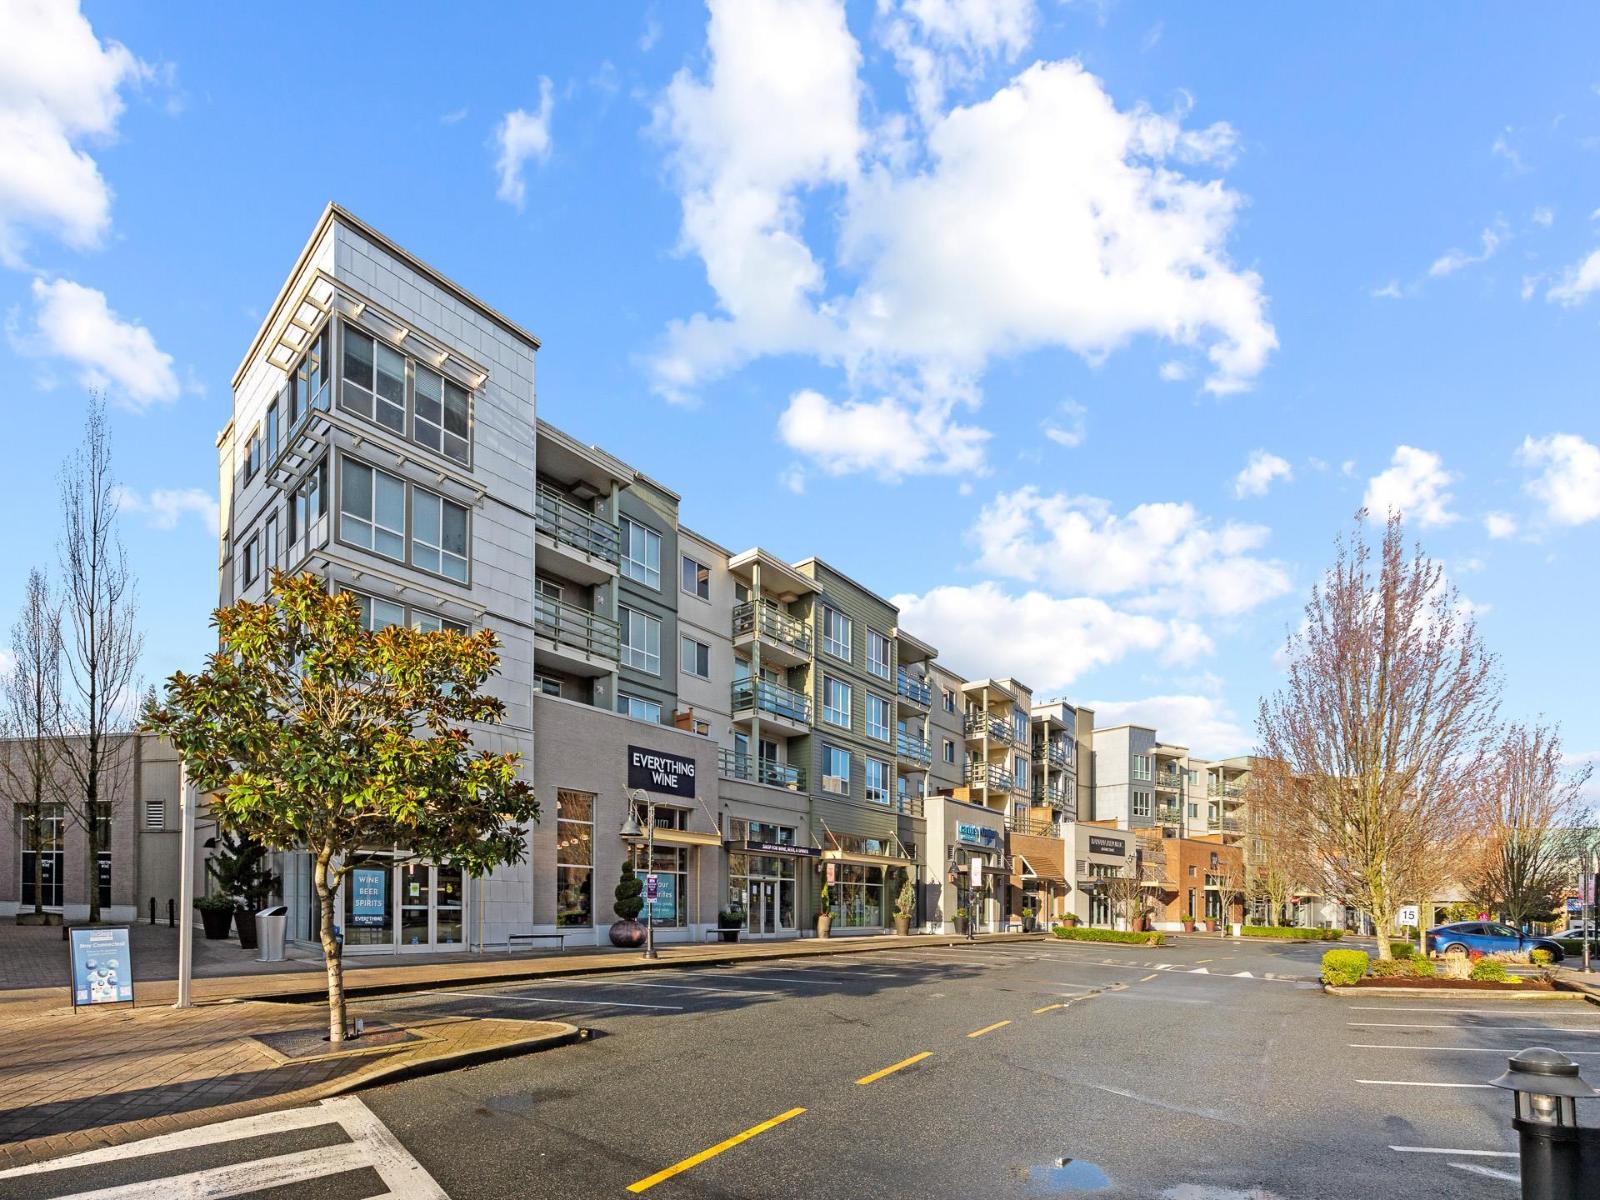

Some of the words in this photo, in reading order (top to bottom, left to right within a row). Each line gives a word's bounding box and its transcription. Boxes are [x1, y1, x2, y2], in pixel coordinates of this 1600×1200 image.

[633, 752, 694, 777] EVERYTHING
[652, 771, 678, 788] WINE
[359, 876, 379, 884] WINE
[355, 899, 382, 907] SPIRITS
[1403, 910, 1415, 919] 15
